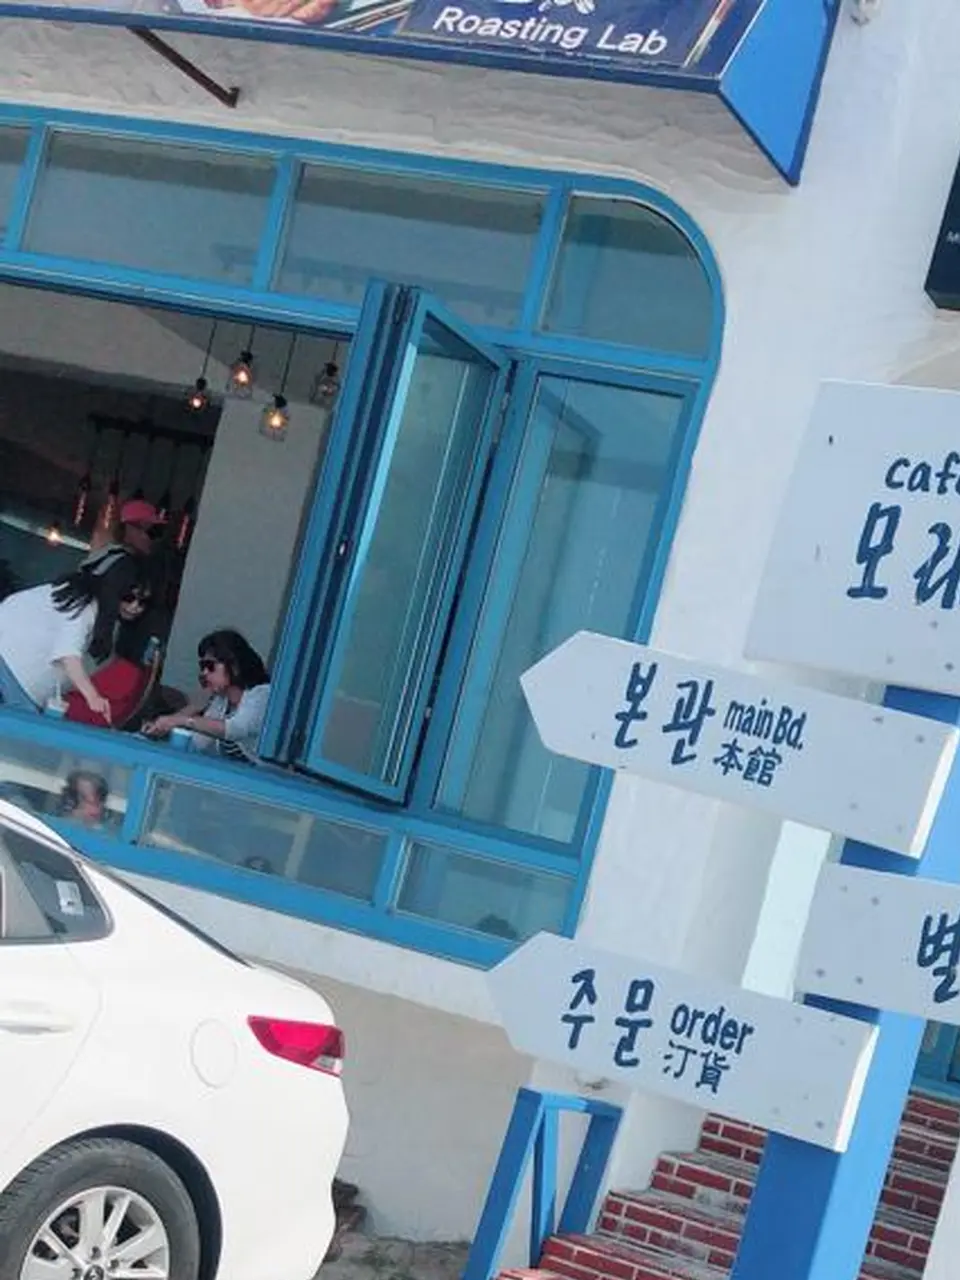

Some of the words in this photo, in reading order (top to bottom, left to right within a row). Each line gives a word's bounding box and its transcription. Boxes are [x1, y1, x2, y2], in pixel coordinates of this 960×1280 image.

[433, 6, 588, 49] Roasting
[597, 24, 667, 55] Lab
[613, 662, 716, 765] 본관
[713, 738, 783, 787] 本館
[561, 968, 655, 1068] 주문
[670, 1003, 755, 1055] order
